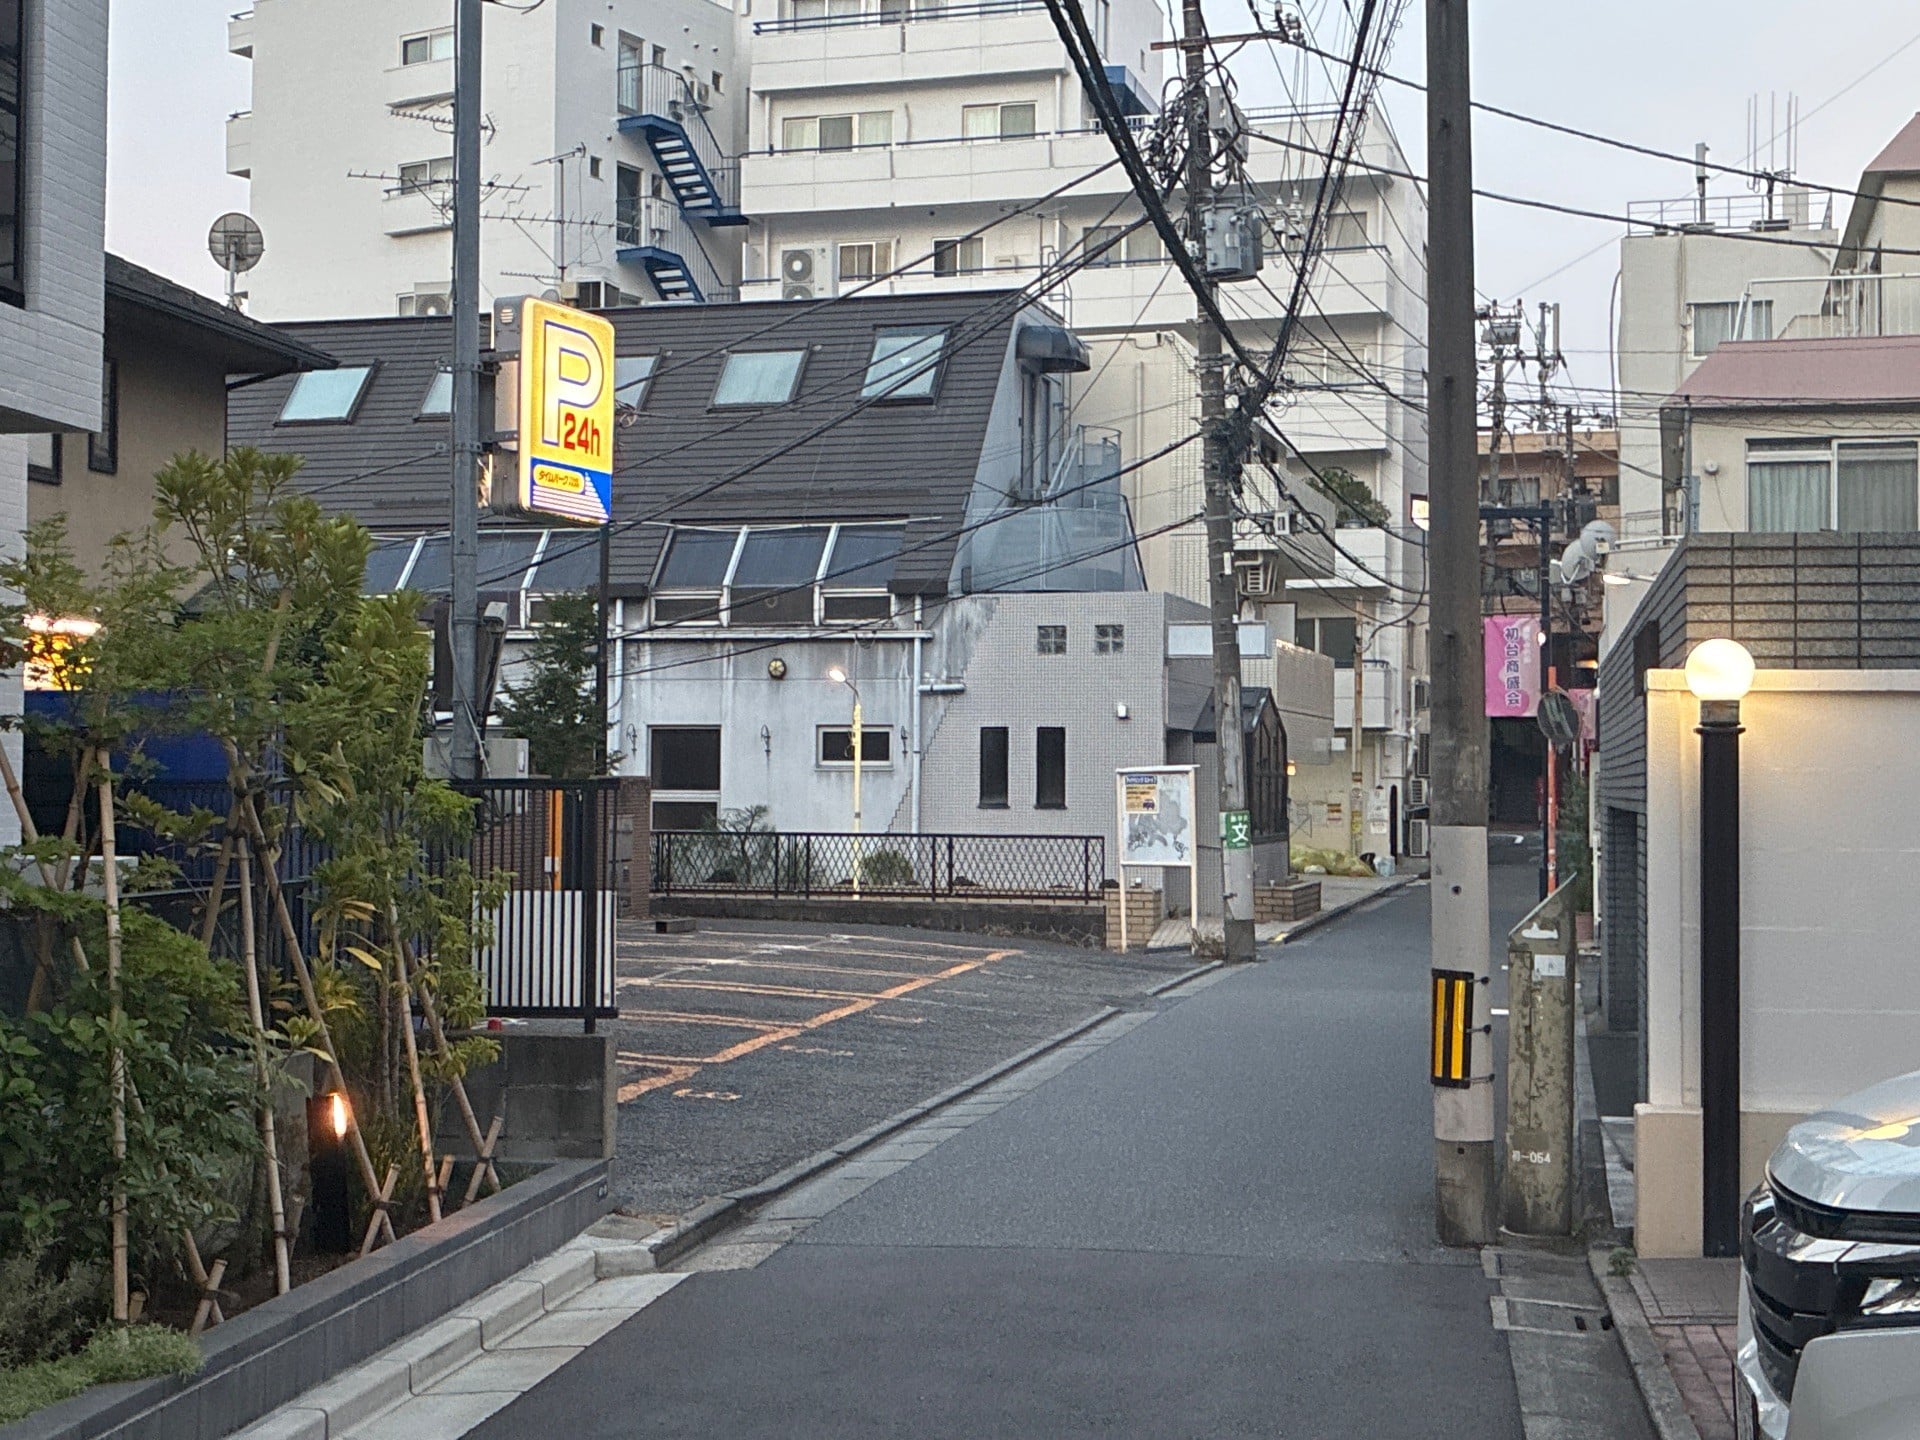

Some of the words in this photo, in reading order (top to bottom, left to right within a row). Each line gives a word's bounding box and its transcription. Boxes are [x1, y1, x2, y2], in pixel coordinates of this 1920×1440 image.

[542, 320, 605, 447] P
[563, 412, 601, 457] 24h
[1231, 822, 1249, 843] 文
